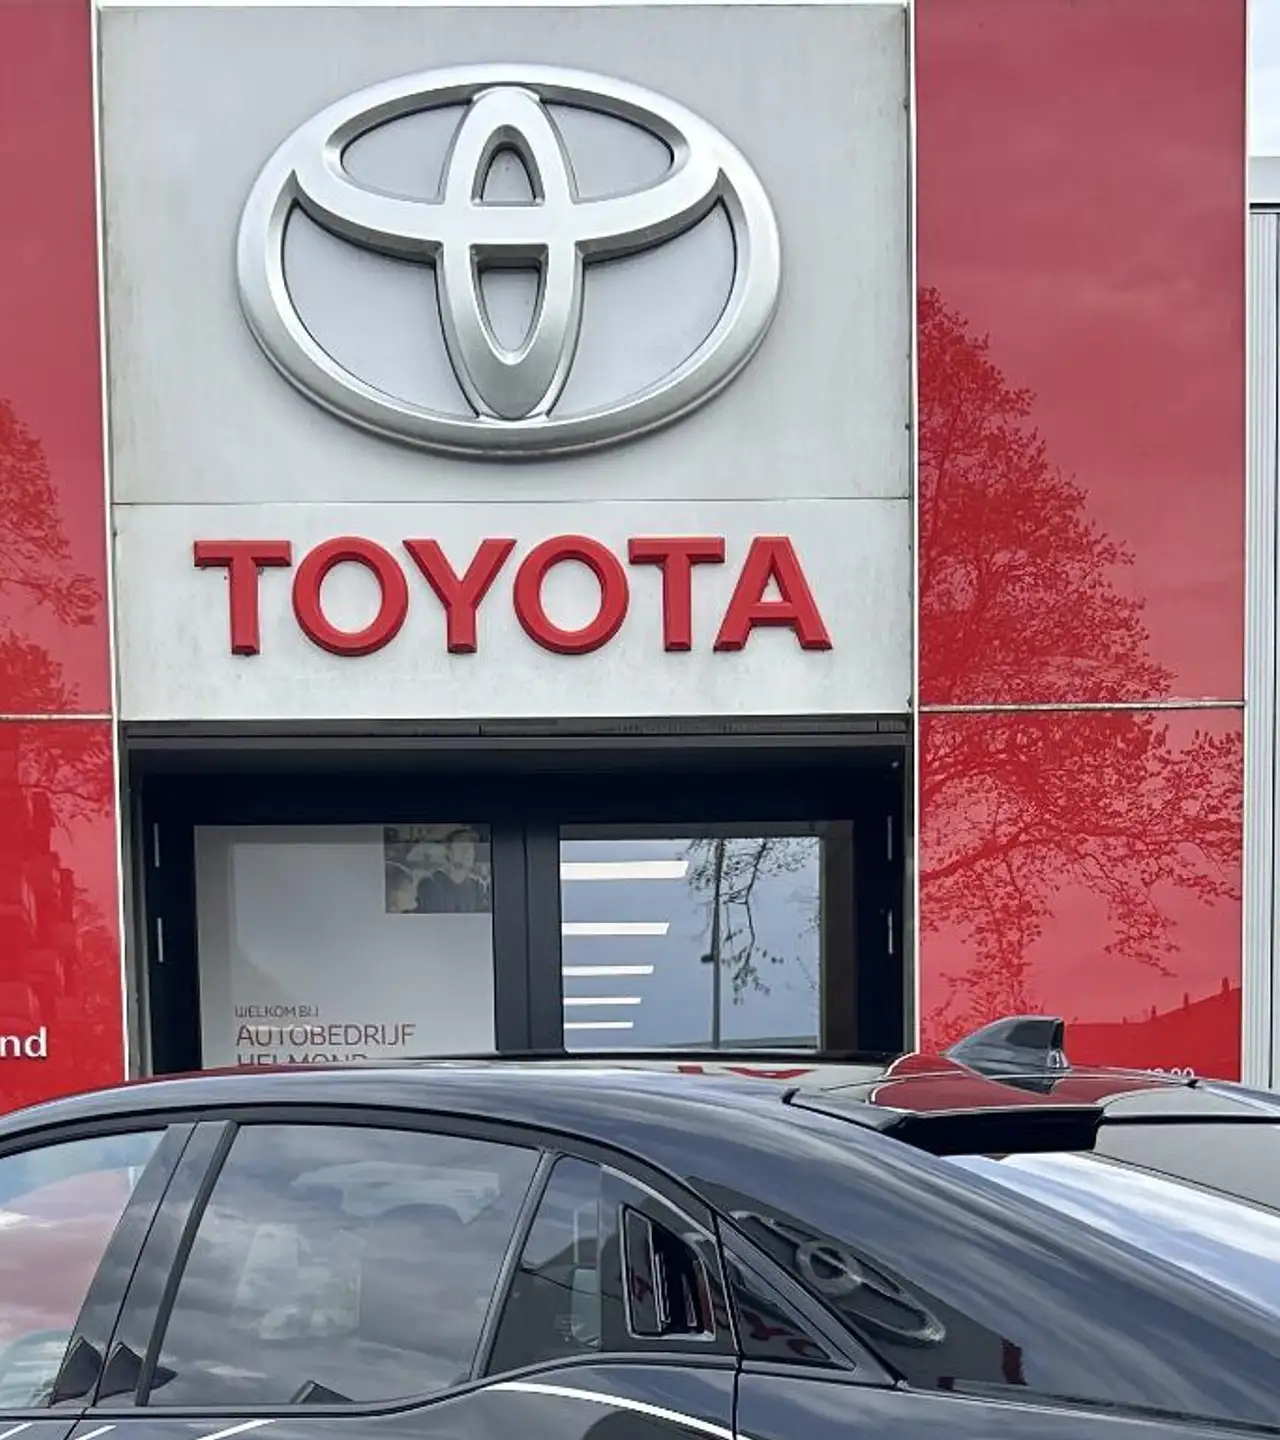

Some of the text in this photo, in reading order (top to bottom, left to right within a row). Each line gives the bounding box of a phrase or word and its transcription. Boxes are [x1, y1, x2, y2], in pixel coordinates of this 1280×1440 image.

[194, 535, 833, 658] TOYOTA
[234, 1004, 296, 1018] WELKOM
[235, 1023, 417, 1047] AUTOBEDRIJF
